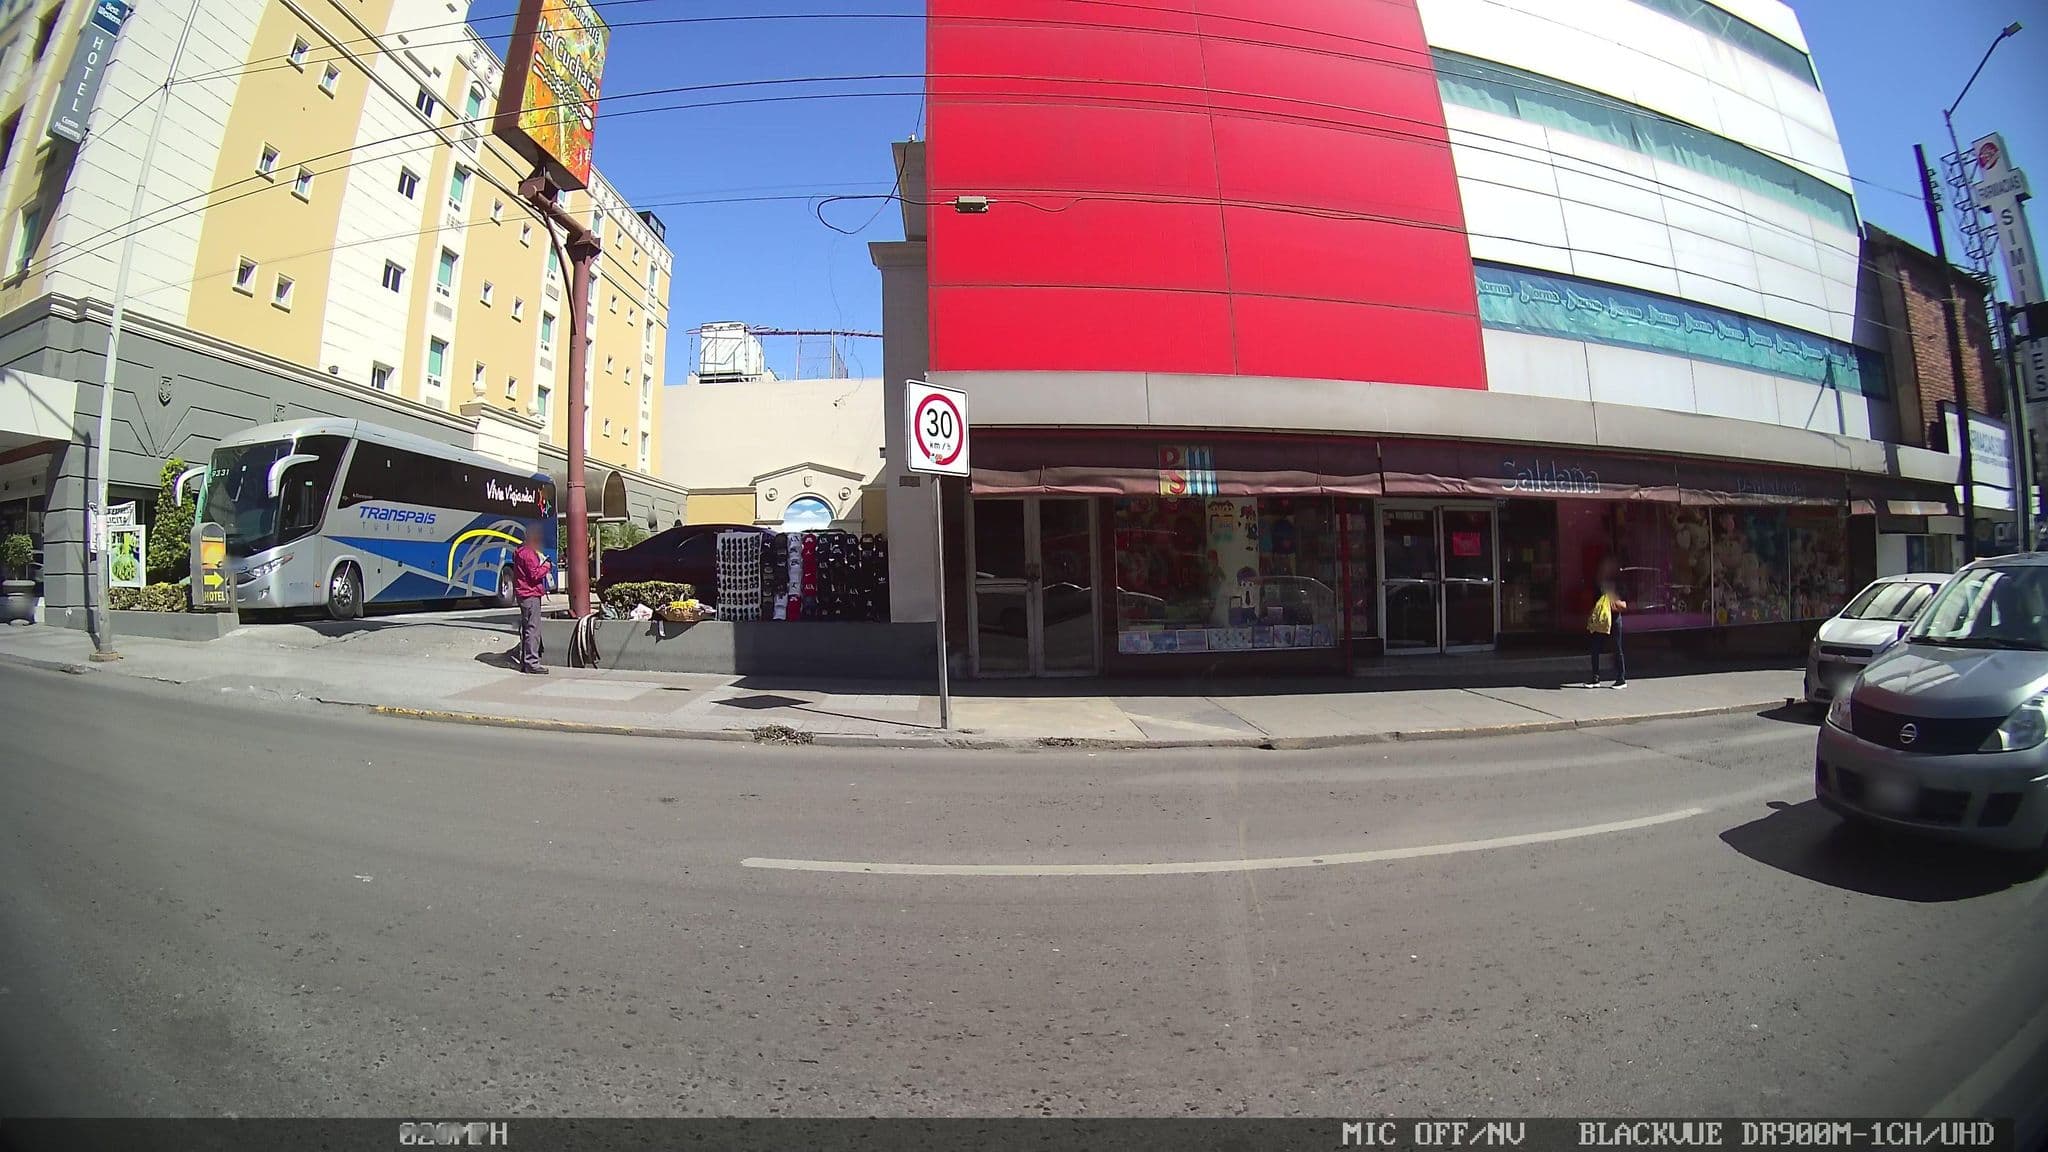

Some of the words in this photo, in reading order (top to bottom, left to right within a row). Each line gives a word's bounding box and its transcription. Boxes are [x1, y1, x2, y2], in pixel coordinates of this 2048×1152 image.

[72, 36, 104, 112] HOTEL
[927, 408, 952, 439] 30
[1502, 459, 1600, 494] Saldaña
[362, 521, 434, 535] TURISMO
[203, 592, 226, 601] HOTEL
